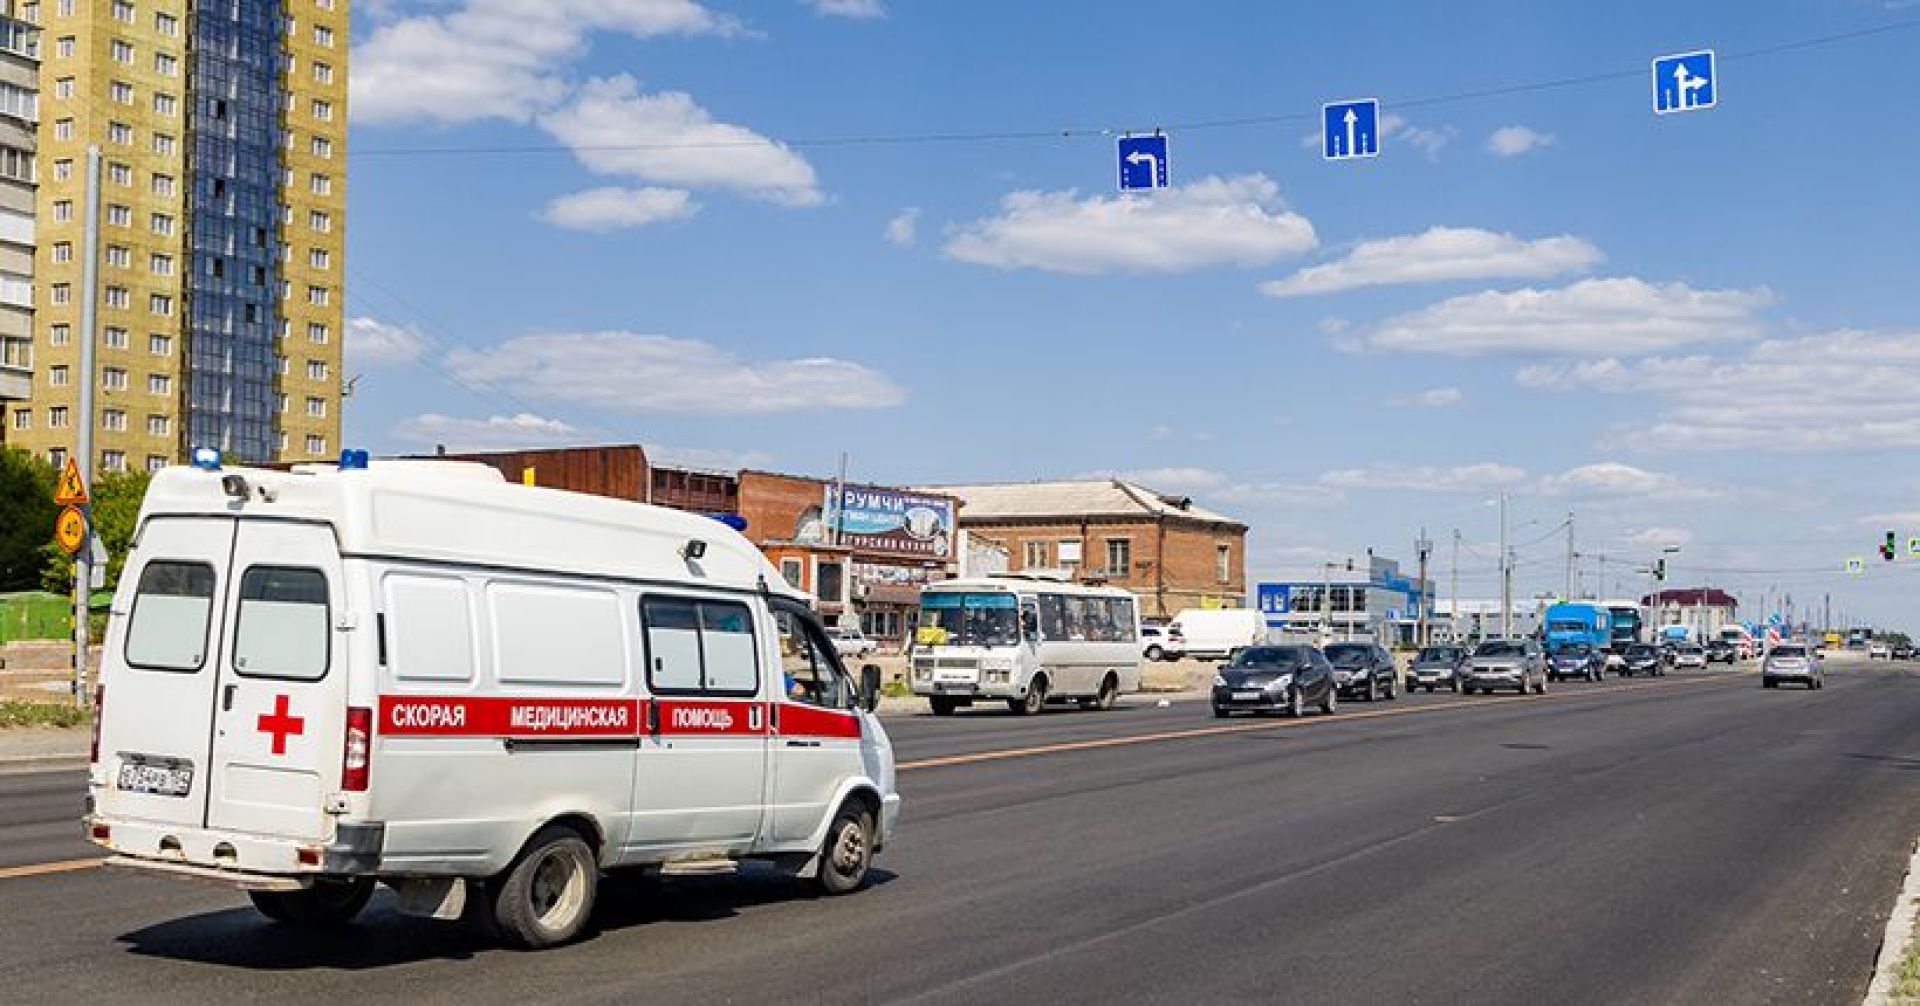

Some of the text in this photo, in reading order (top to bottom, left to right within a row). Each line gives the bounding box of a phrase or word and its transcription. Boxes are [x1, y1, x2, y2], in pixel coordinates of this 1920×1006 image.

[65, 520, 79, 538] 40
[391, 703, 733, 731] СКОРАЯ МЕДИЦИНСКАЯ ПОМОЩЬ
